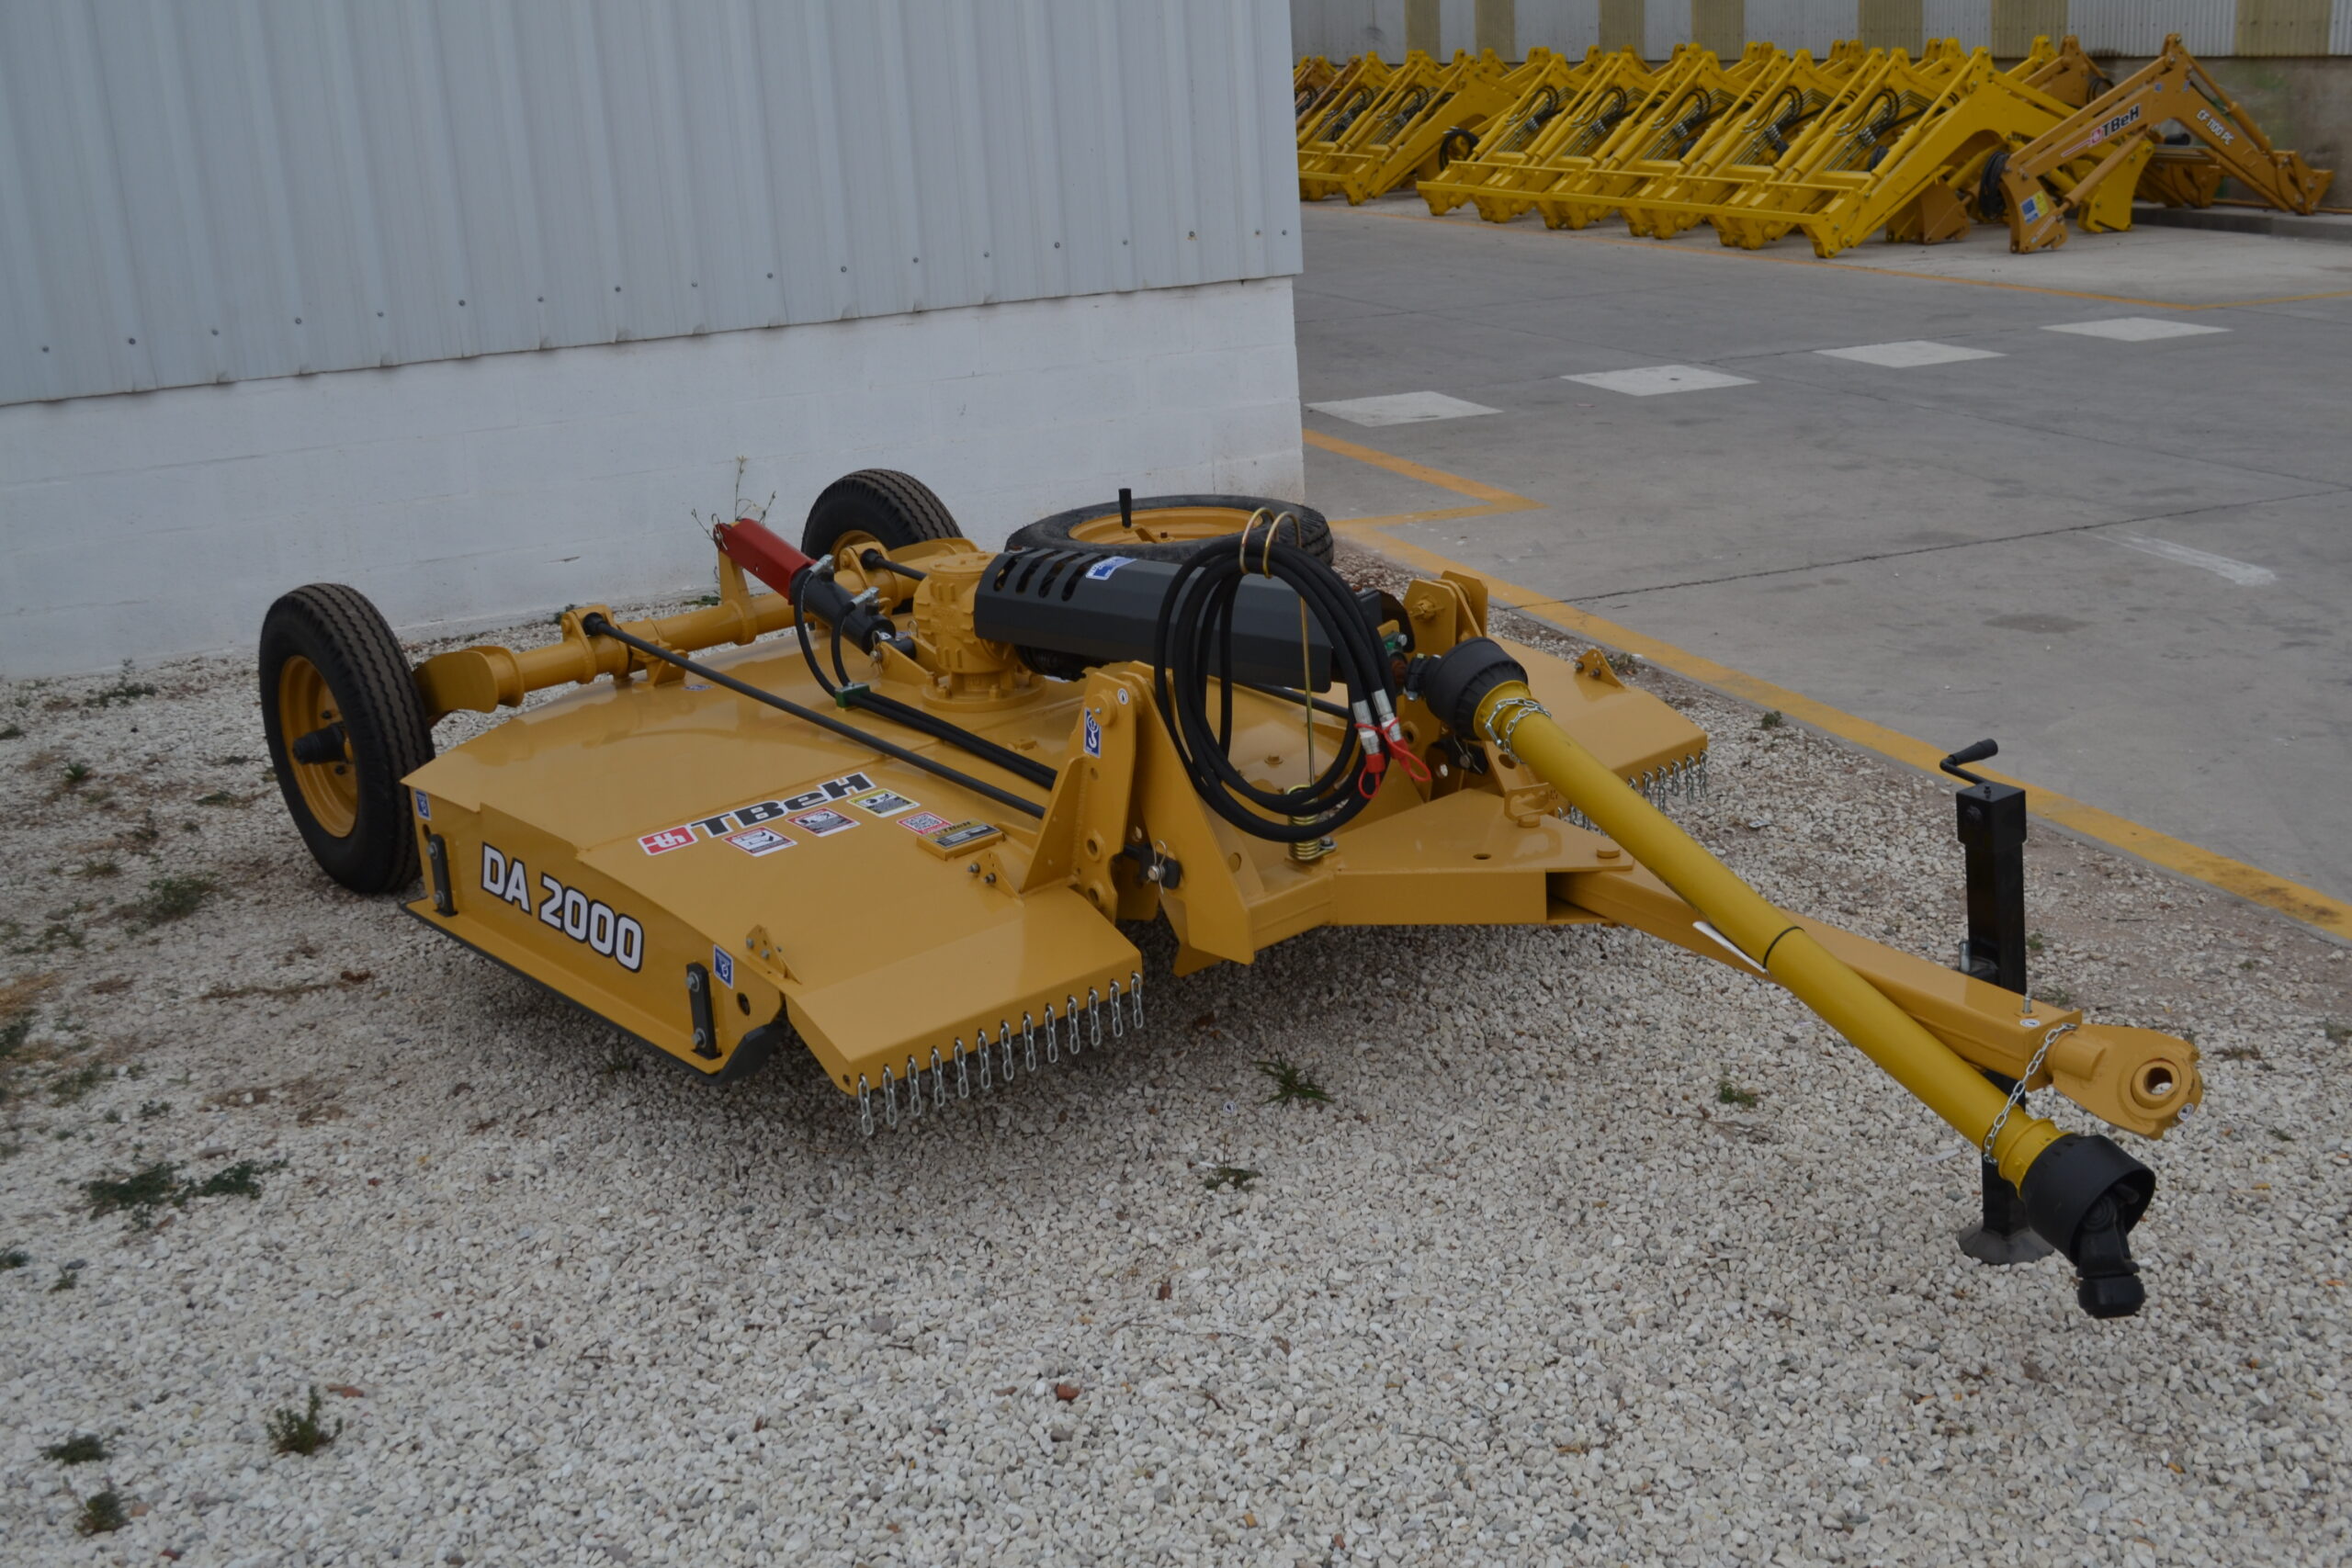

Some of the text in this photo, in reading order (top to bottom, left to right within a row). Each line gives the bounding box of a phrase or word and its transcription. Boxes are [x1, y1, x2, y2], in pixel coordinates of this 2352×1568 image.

[2102, 105, 2139, 137] TBeH
[691, 773, 873, 836] TBeH
[481, 842, 644, 973] DA 2000
